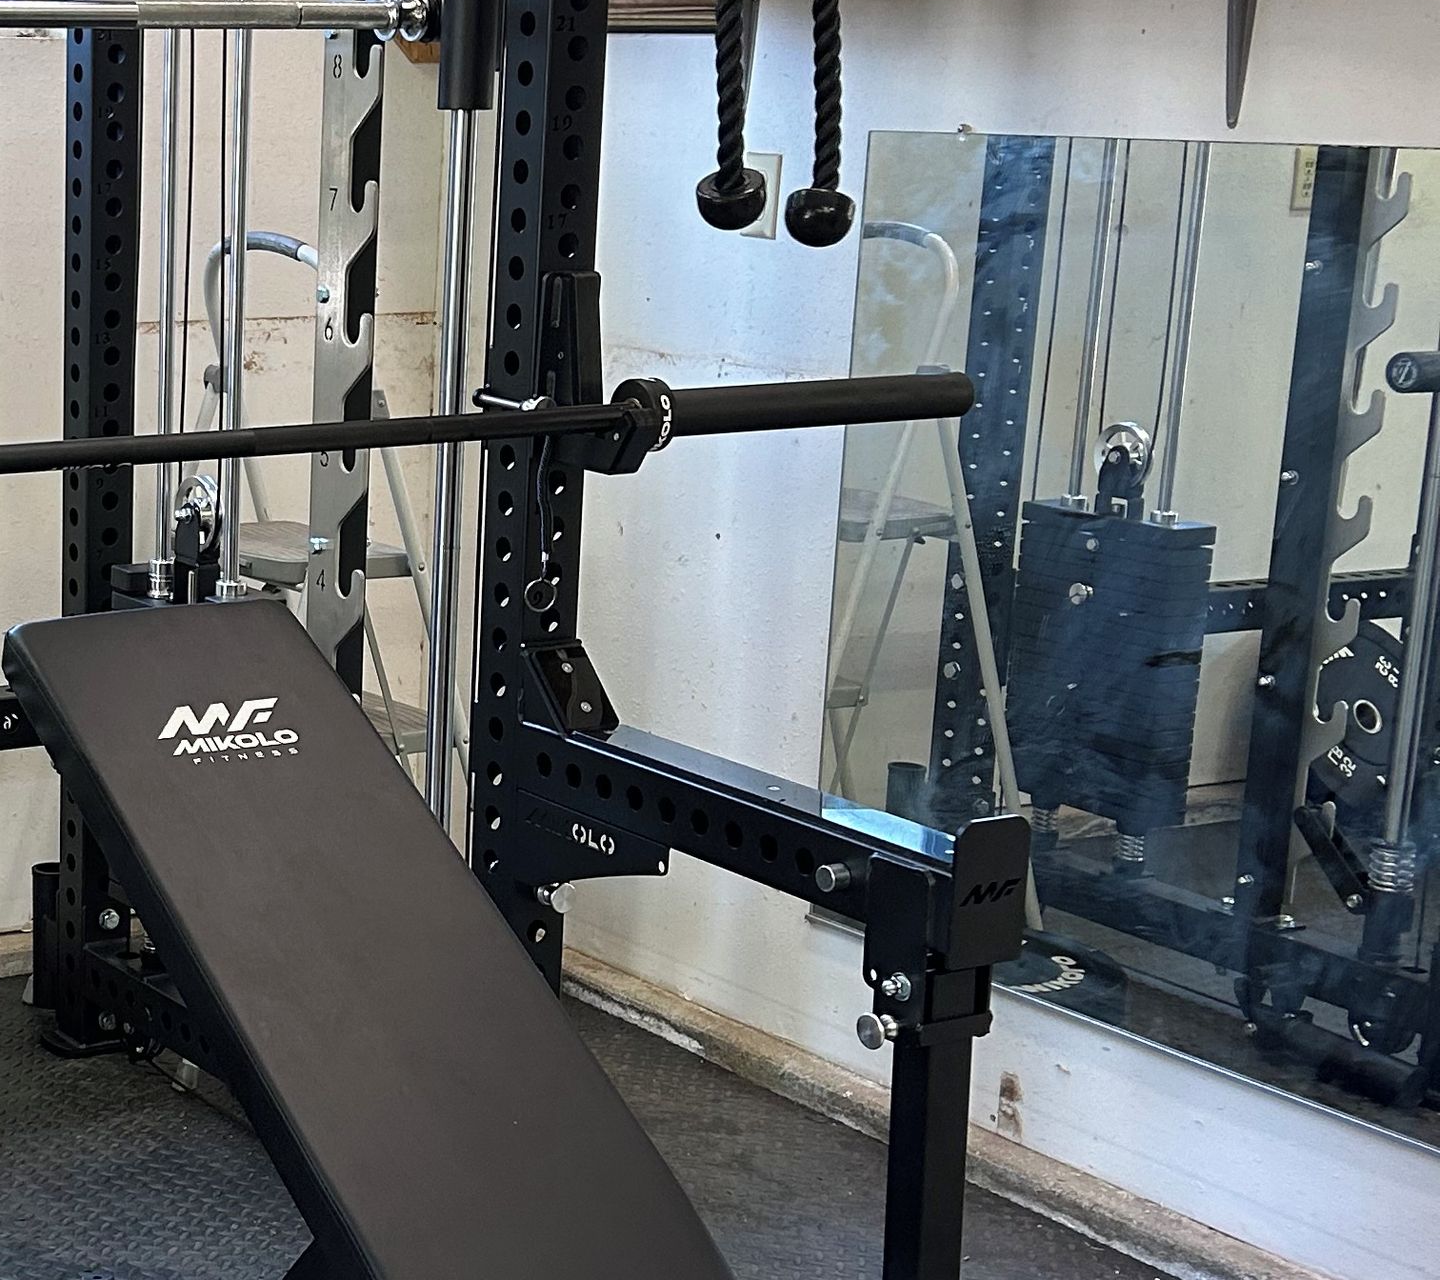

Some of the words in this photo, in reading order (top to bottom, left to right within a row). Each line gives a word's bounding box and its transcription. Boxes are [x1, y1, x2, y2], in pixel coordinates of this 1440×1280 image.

[333, 54, 343, 79] 8
[329, 187, 339, 212] 7
[324, 317, 334, 342] 6
[316, 569, 326, 592] 4
[173, 729, 299, 756] MIKOLO
[192, 747, 298, 765] FITNESS
